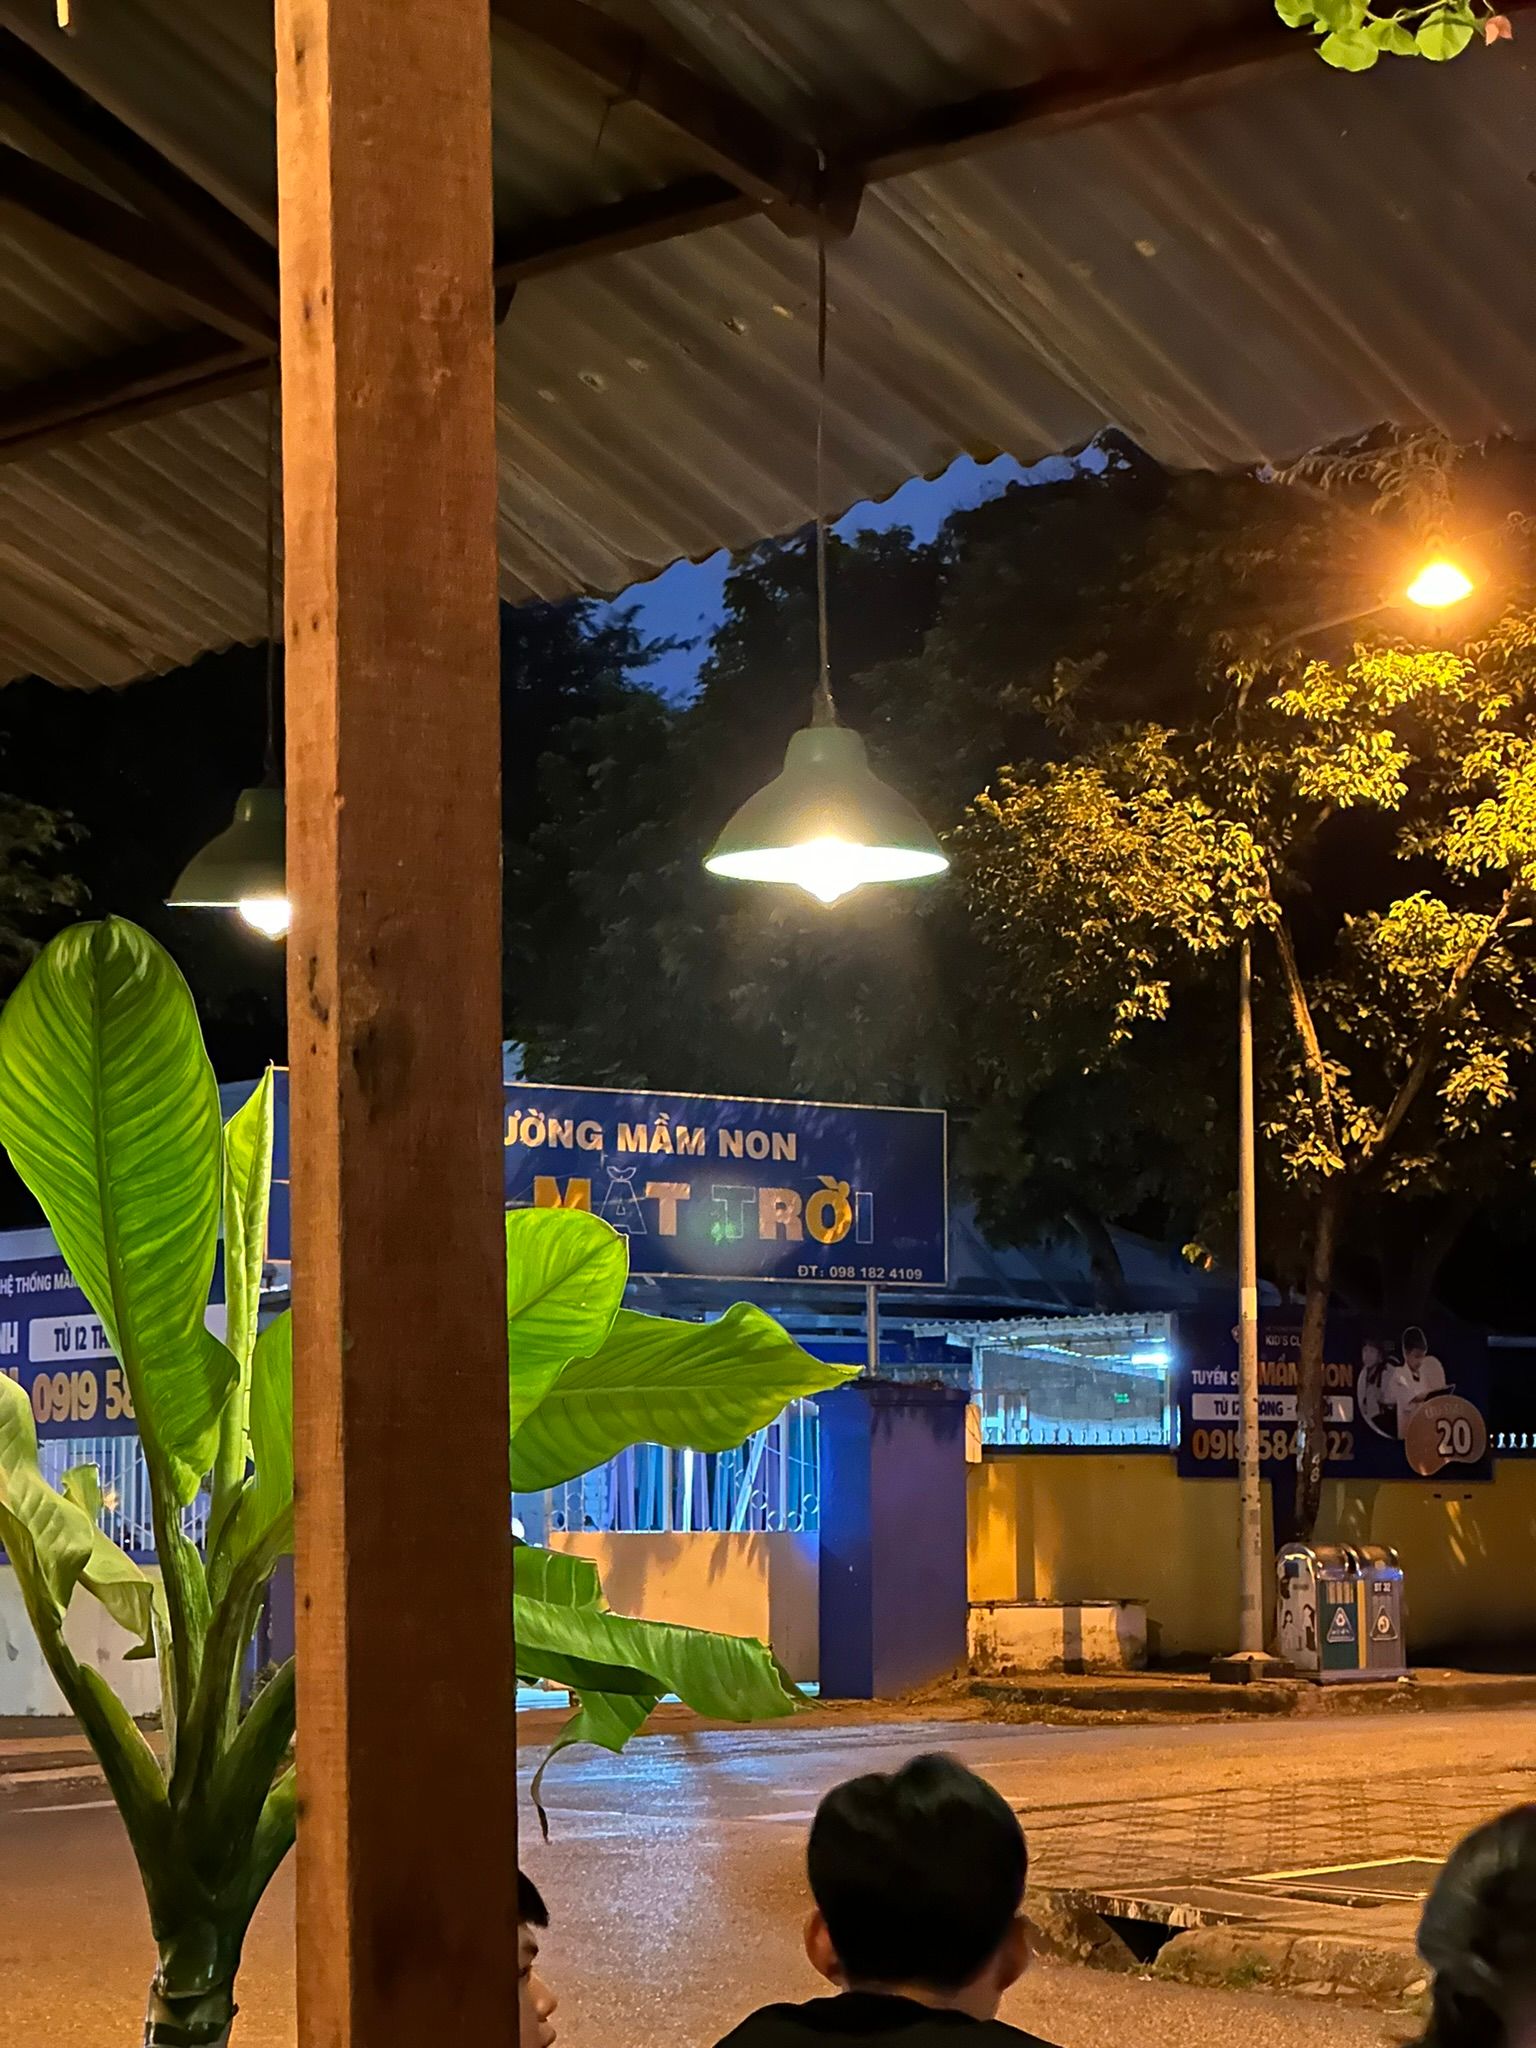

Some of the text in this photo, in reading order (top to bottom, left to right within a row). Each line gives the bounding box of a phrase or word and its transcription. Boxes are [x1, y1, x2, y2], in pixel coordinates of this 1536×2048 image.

[504, 1108, 798, 1162] ƯỜNG MẦM NON
[711, 1174, 874, 1245] TRỜI
[15, 1271, 52, 1294] THỐNG
[829, 1265, 856, 1279] 098
[860, 1267, 885, 1280] 182
[889, 1268, 923, 1281] 4109
[1265, 1334, 1302, 1347] KID'S CL
[32, 1370, 98, 1424] 0919
[1259, 1398, 1283, 1416] ÁNG
[1437, 1418, 1473, 1456] 20
